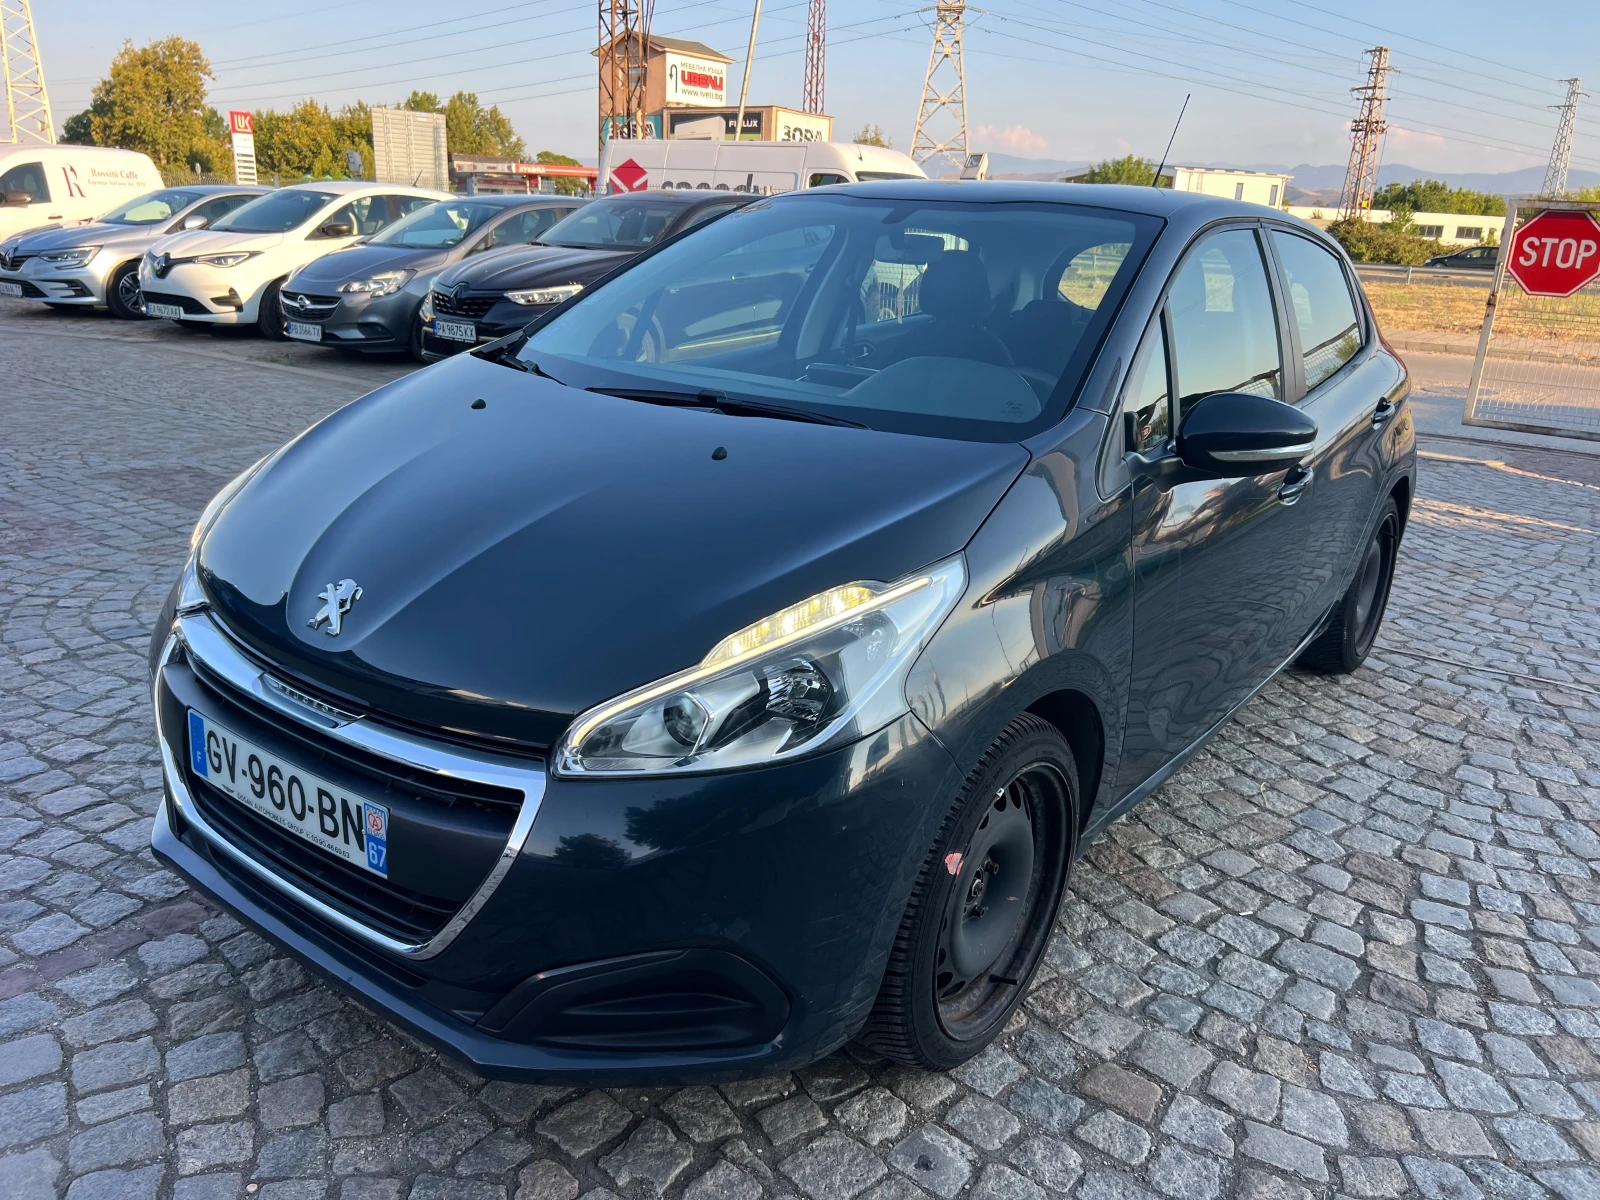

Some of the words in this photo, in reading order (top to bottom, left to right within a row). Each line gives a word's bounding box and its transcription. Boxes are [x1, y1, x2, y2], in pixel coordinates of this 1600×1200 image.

[681, 88, 723, 102] www.iveli.bg
[728, 118, 758, 128] FILUX
[90, 167, 119, 178] Rossini
[1518, 236, 1598, 269] STOP
[196, 750, 202, 763] F
[206, 730, 366, 853] GV-960-BN
[368, 841, 387, 868] 67
